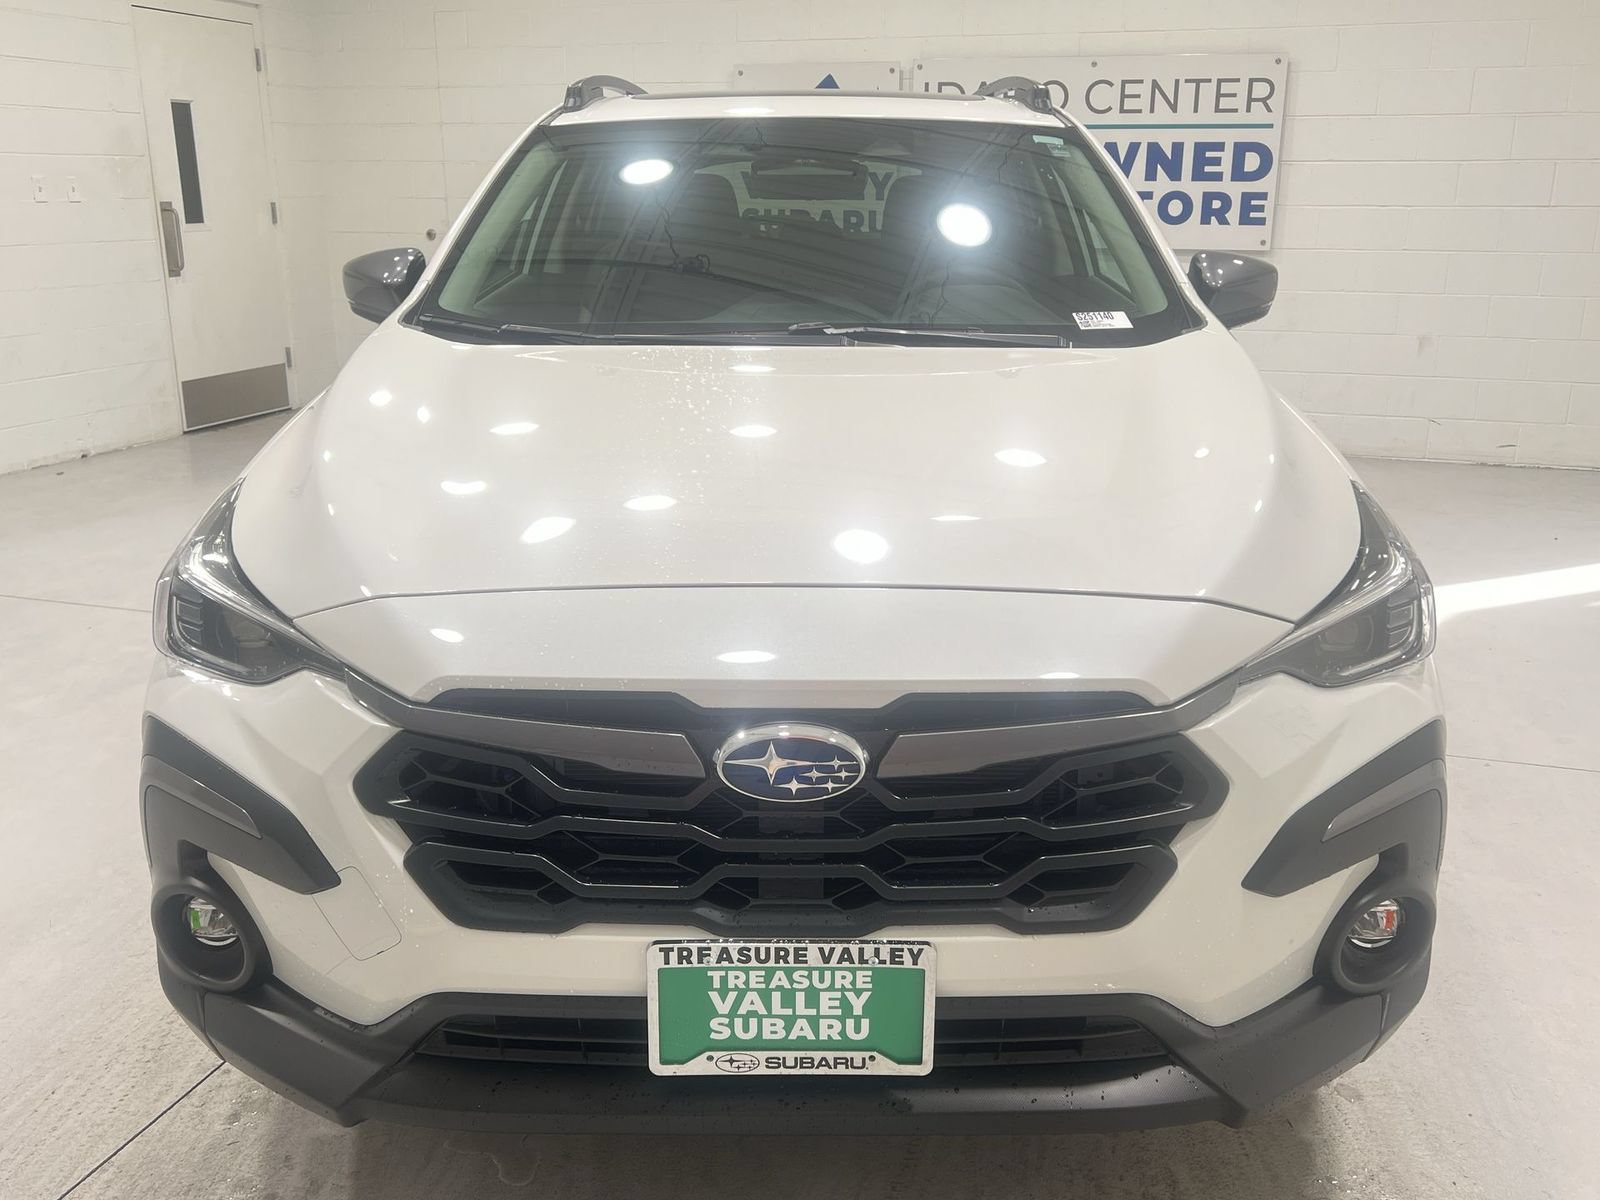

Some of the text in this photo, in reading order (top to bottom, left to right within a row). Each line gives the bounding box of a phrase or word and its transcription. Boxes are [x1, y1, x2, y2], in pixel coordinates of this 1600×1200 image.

[1084, 77, 1276, 115] CENTER
[658, 946, 924, 967] TREASURE VALLEY
[706, 970, 873, 989] TREASURE
[707, 991, 873, 1016] VALLEY
[709, 1017, 870, 1041] SUBARU
[764, 1056, 868, 1070] SUBARU
